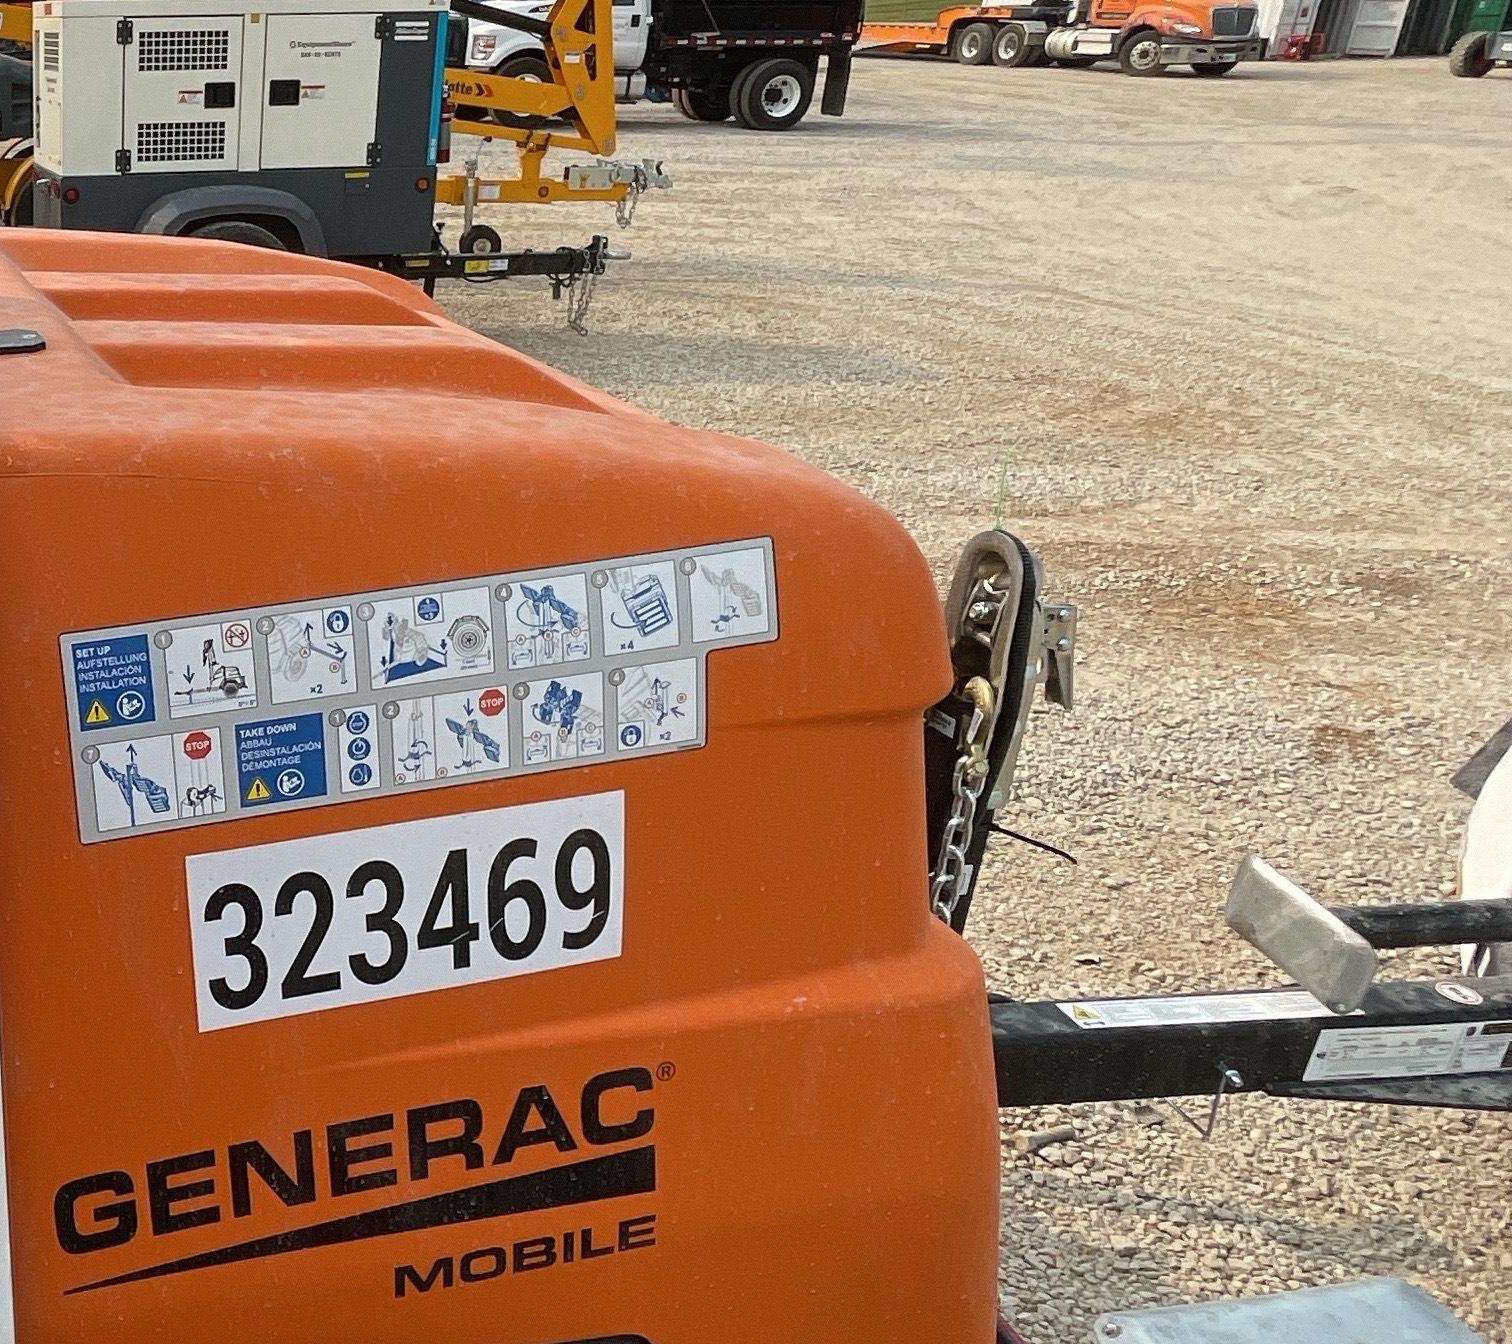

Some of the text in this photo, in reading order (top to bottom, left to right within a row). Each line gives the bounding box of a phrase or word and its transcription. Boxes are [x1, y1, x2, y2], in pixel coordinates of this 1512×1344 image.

[75, 645, 112, 658] SET UP
[620, 640, 635, 651] x4
[76, 652, 148, 670] AUFSTELLUNG
[78, 663, 143, 682] INSTALACIÓN
[79, 676, 147, 693] INSTALLATION
[309, 684, 324, 695] x2
[480, 696, 504, 710] STOP
[239, 722, 297, 739] TAKE DOWN
[659, 731, 672, 741] x2
[185, 740, 210, 753] STOP
[239, 738, 273, 750] ABBAU
[241, 740, 322, 761] DESINSTALACIÓN
[202, 828, 611, 1011] 323469
[53, 1067, 656, 1256] GENERAC
[392, 1214, 657, 1298] MOBILE
